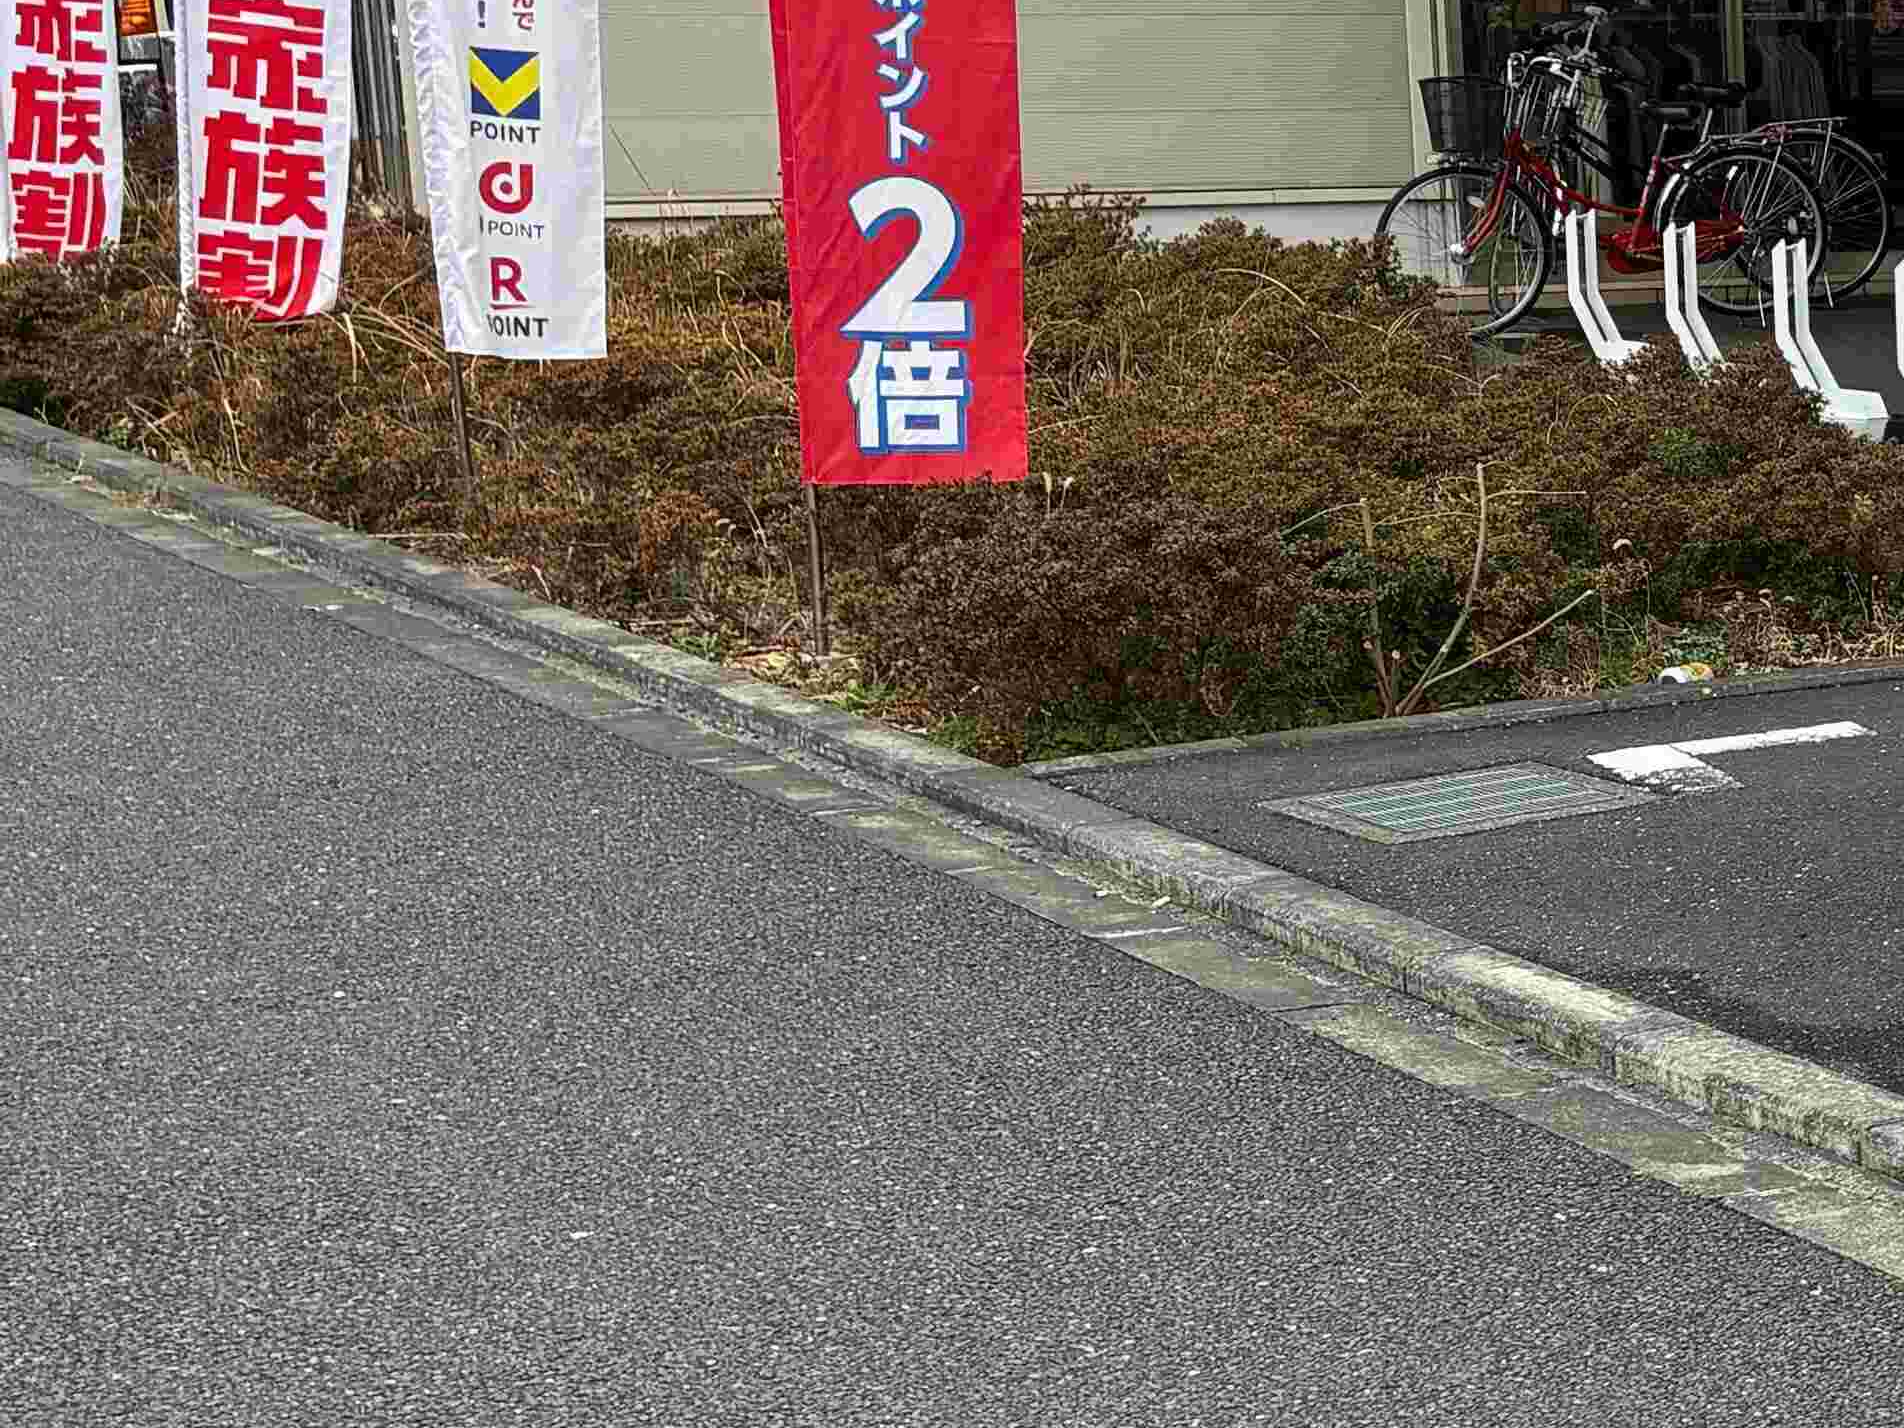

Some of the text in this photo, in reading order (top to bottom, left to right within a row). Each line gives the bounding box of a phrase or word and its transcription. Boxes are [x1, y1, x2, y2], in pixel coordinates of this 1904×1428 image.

[470, 120, 541, 146] POINT
[489, 257, 527, 304] R
[838, 175, 972, 454] 2倍
